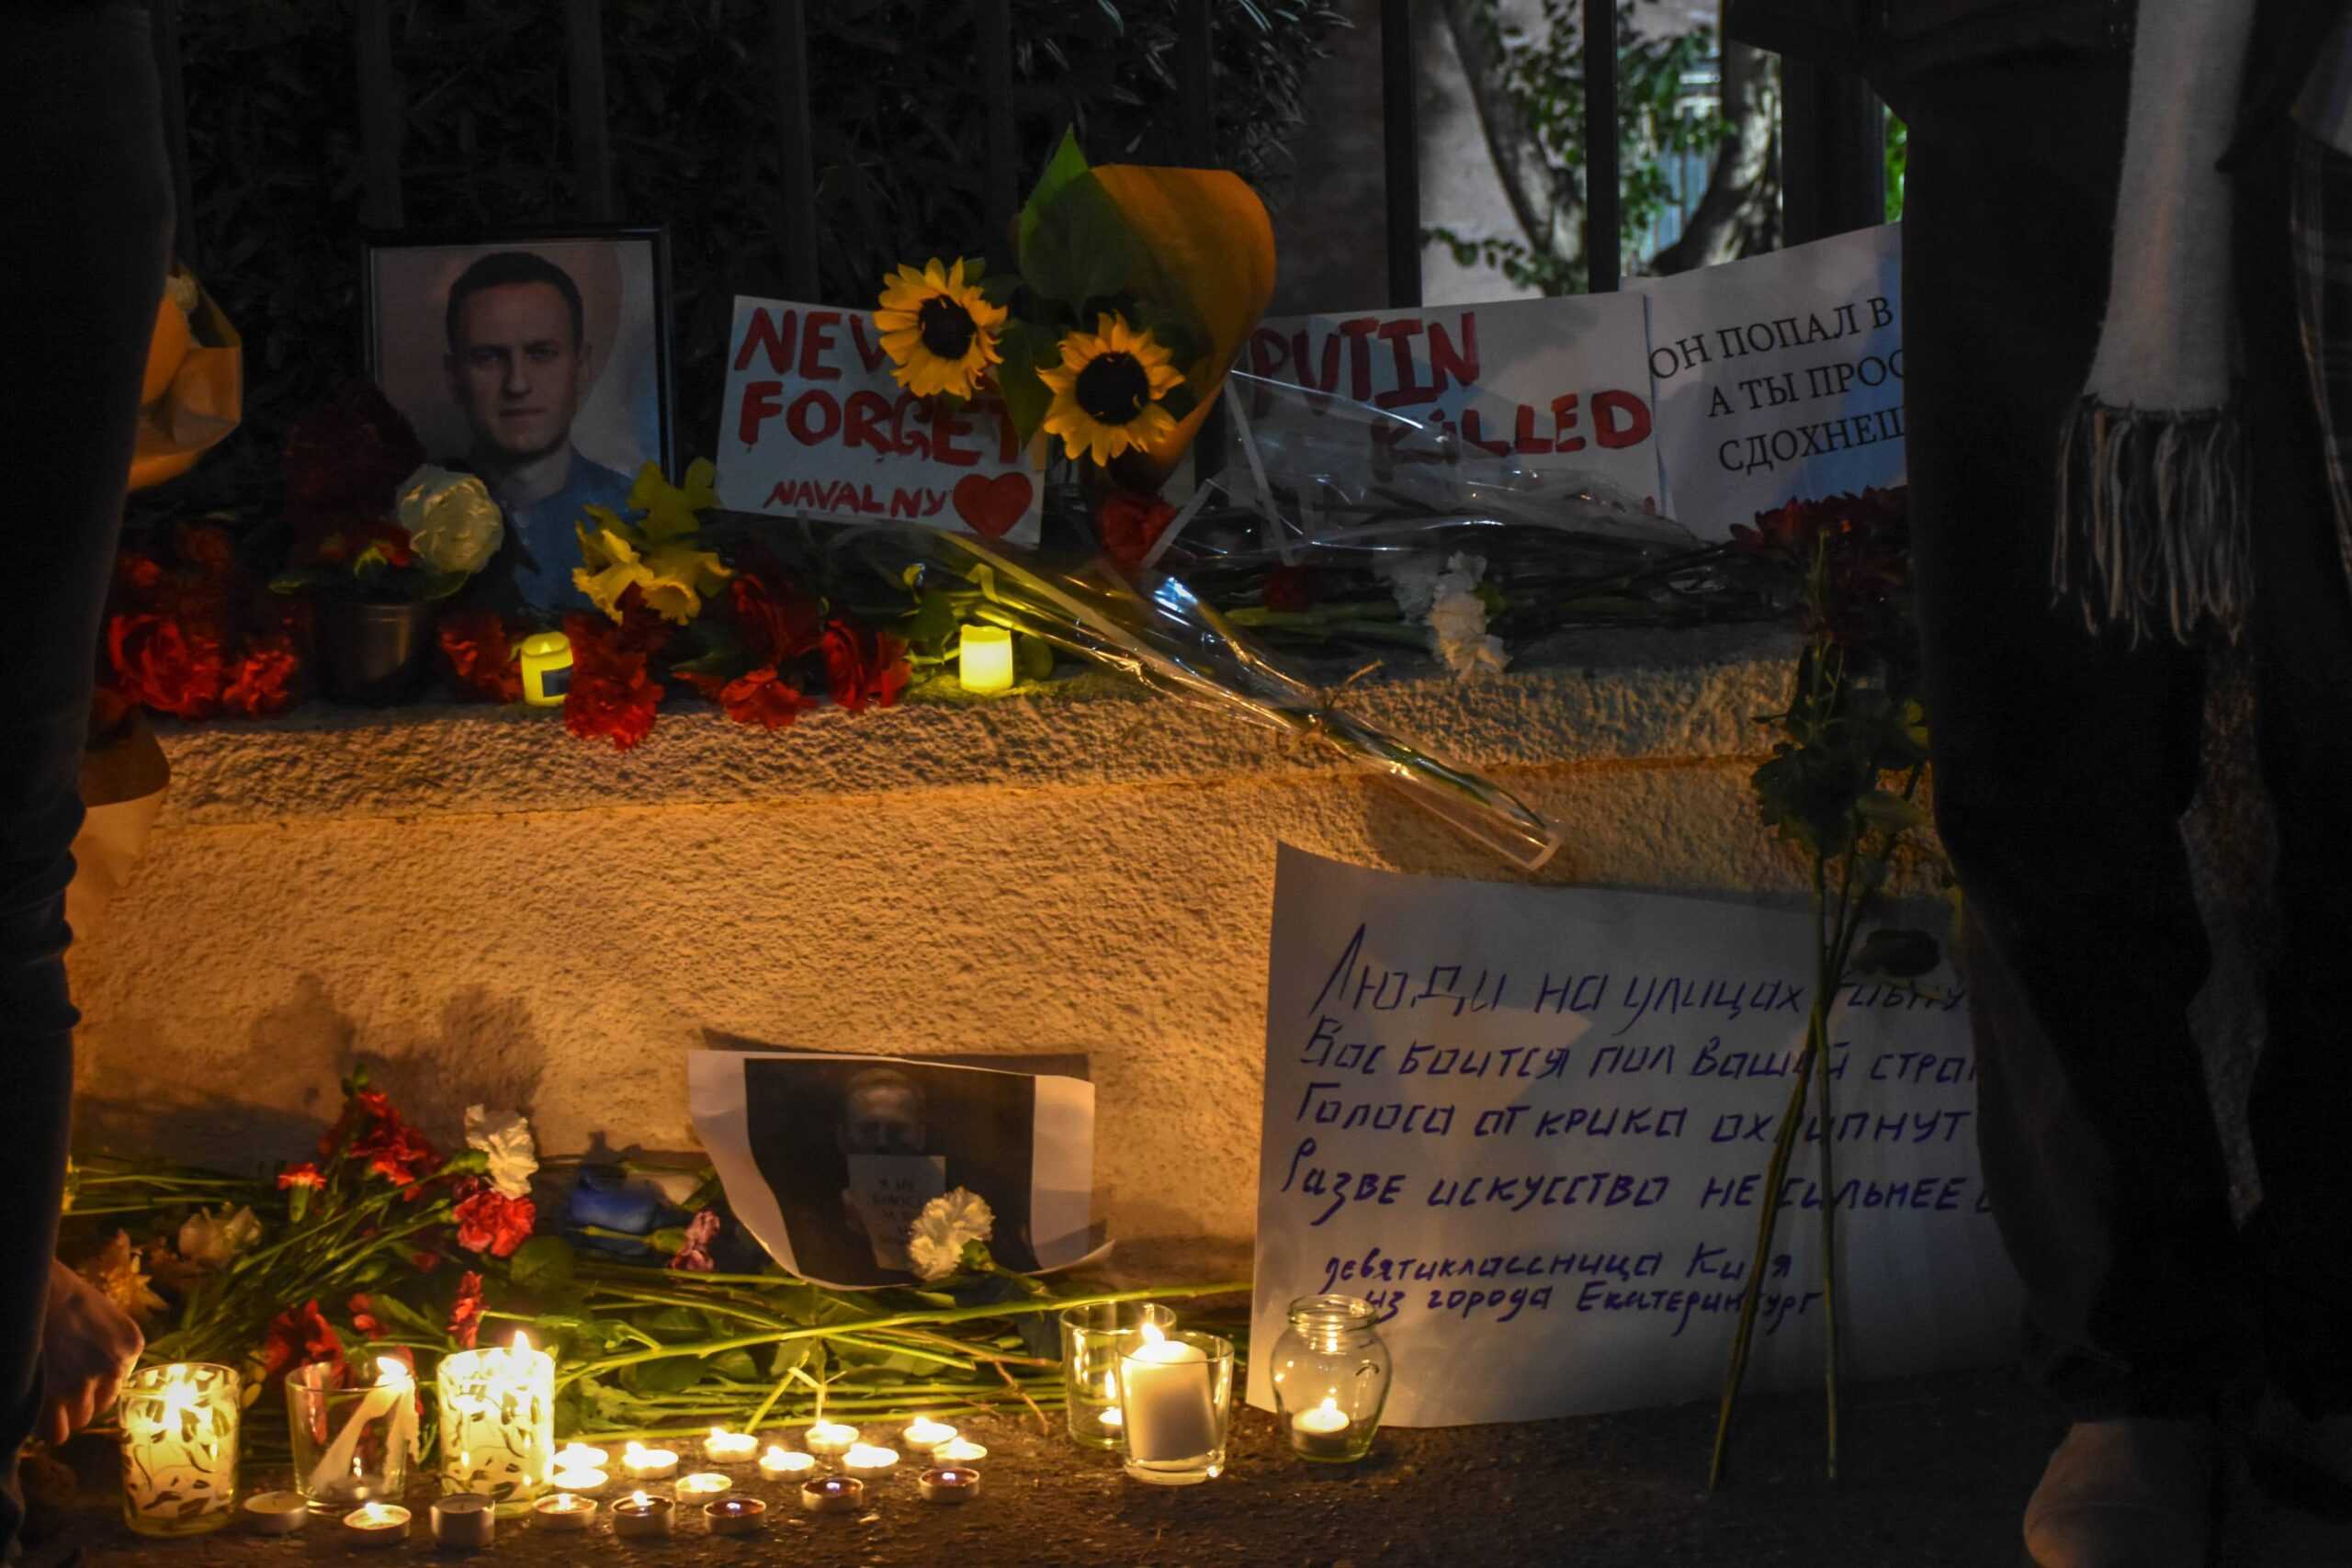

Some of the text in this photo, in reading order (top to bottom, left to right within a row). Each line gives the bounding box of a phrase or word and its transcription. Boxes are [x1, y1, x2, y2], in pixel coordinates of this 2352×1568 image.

[1649, 297, 1893, 378] ОН ПОПАЛ В
[1249, 311, 1480, 418] PUTIN
[1708, 386, 1735, 417] А
[1739, 372, 1800, 410] ТЫ
[738, 380, 1019, 466] FORGET
[763, 479, 949, 517] NAVALNY
[1611, 975, 1808, 1036] улицах
[1711, 1110, 1972, 1144] охипнут
[1427, 1172, 1670, 1212] искусство
[1701, 1173, 1761, 1209] не
[1686, 1242, 1792, 1280] Кия
[1427, 1285, 1554, 1323] города
[1577, 1280, 1825, 1337] Екатеринург
